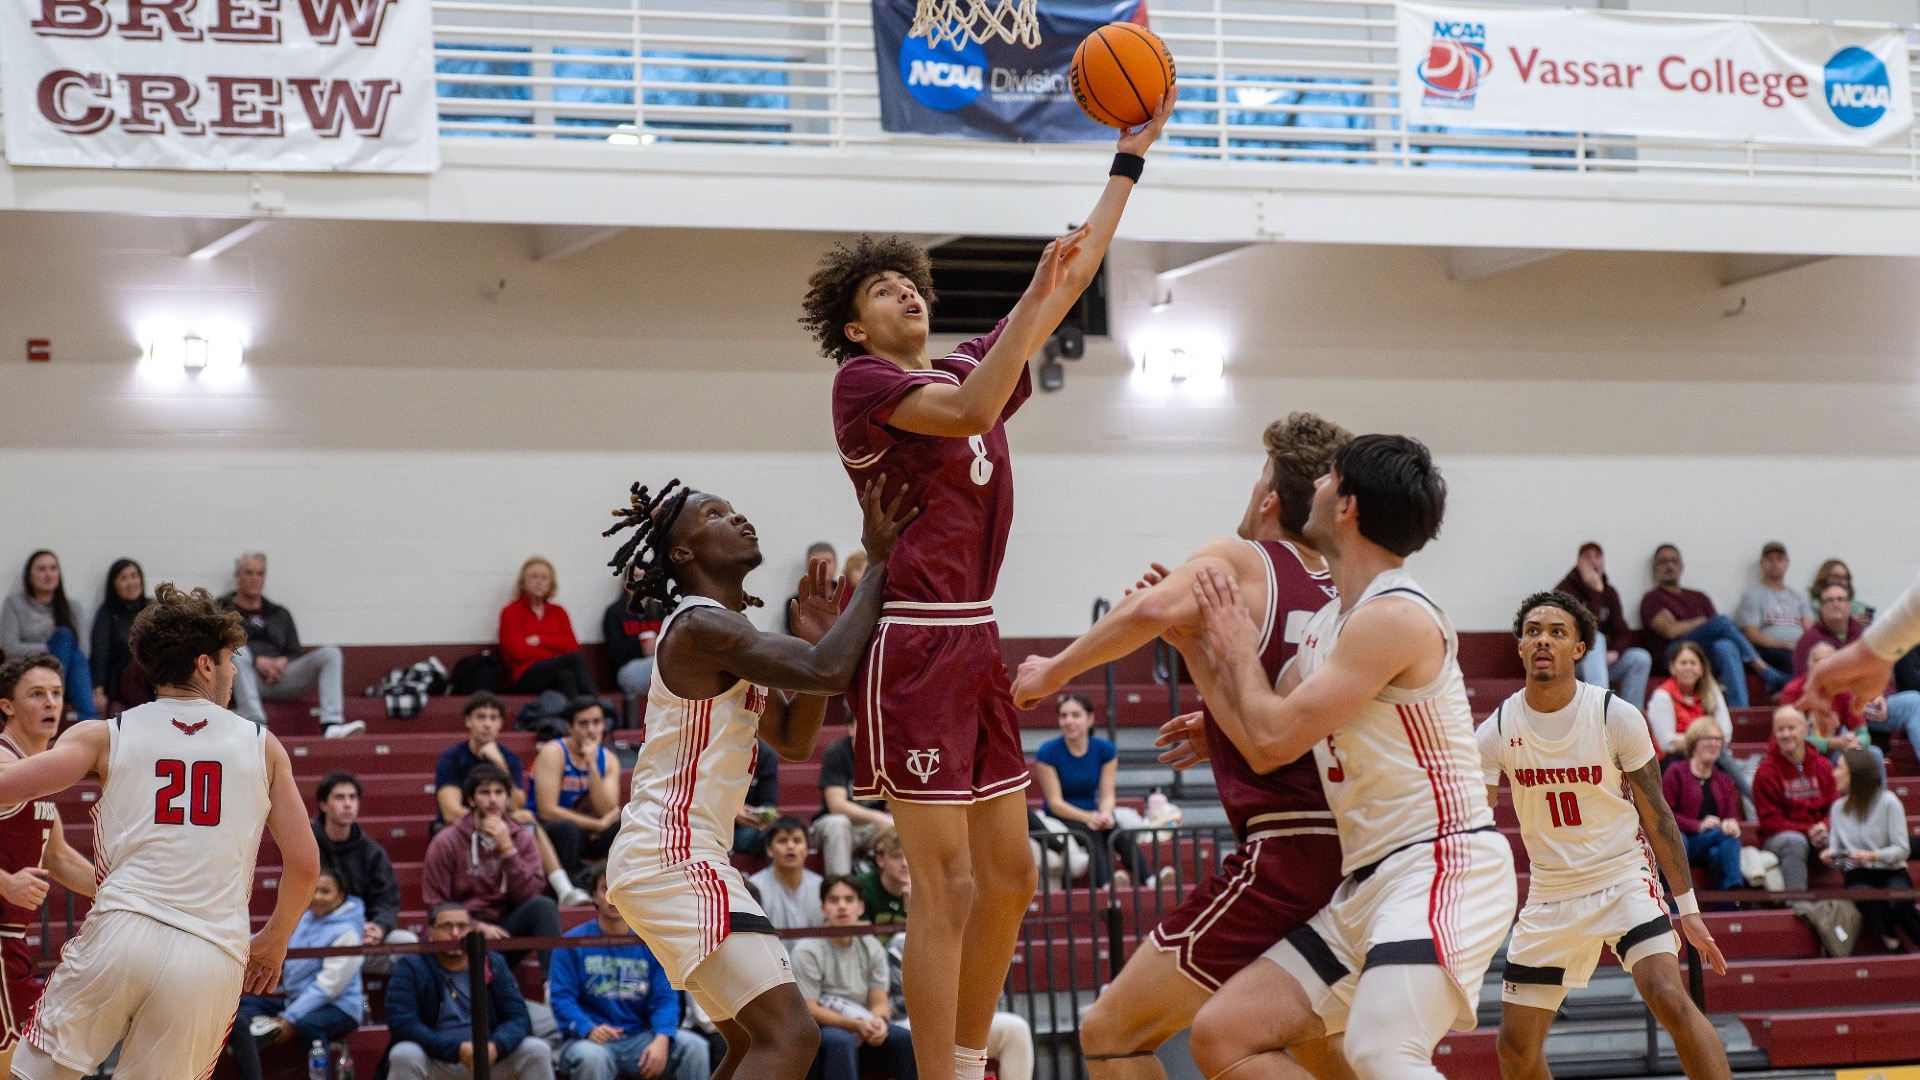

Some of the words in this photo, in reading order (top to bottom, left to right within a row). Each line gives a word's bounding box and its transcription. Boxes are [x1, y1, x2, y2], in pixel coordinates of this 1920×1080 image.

[31, 0, 398, 46] BREW
[1433, 20, 1485, 38] NCAA
[908, 60, 983, 91] NCAA
[991, 67, 1071, 93] Divisio
[1508, 46, 1643, 89] Vassar
[1659, 56, 1809, 108] College
[37, 69, 402, 139] CREW
[1830, 82, 1891, 110] NCAA
[968, 434, 993, 486] 8
[154, 758, 222, 827] 20
[1515, 765, 1603, 788] HARTFORD
[1545, 791, 1582, 829] 10
